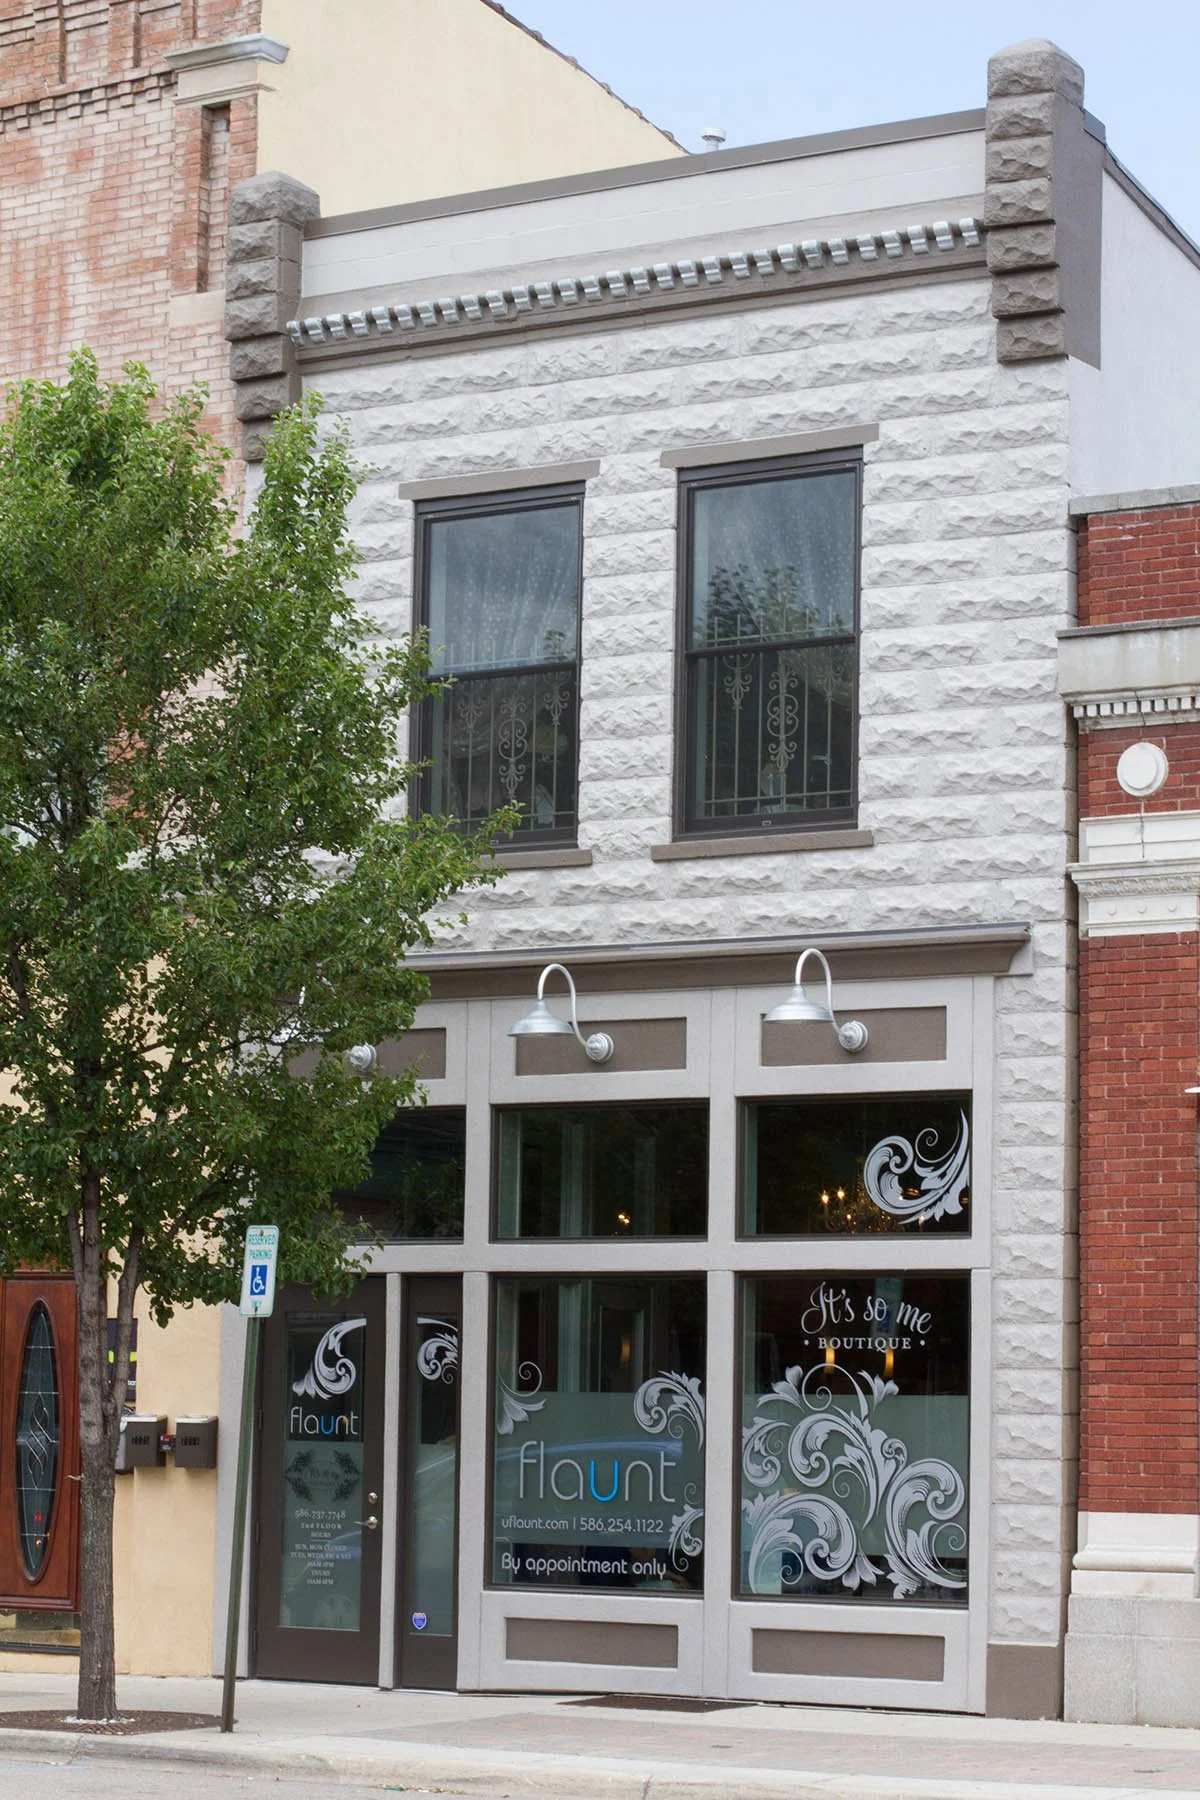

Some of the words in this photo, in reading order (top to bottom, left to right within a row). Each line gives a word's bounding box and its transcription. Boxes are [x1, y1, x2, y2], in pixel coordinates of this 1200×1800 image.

[248, 1234, 276, 1245] RESERVED
[249, 1249, 273, 1259] PARKING
[801, 1281, 855, 1335] It's
[863, 1295, 888, 1321] so
[896, 1301, 932, 1334] me
[818, 1337, 912, 1353] BOUTIQUE
[290, 1406, 359, 1435] flaunt
[519, 1440, 677, 1502] flaunt
[501, 1515, 569, 1530] uflaunt.com
[580, 1517, 664, 1533] 586.254.1122
[501, 1552, 520, 1574] By
[525, 1556, 628, 1576] appointment
[632, 1558, 667, 1580] only
